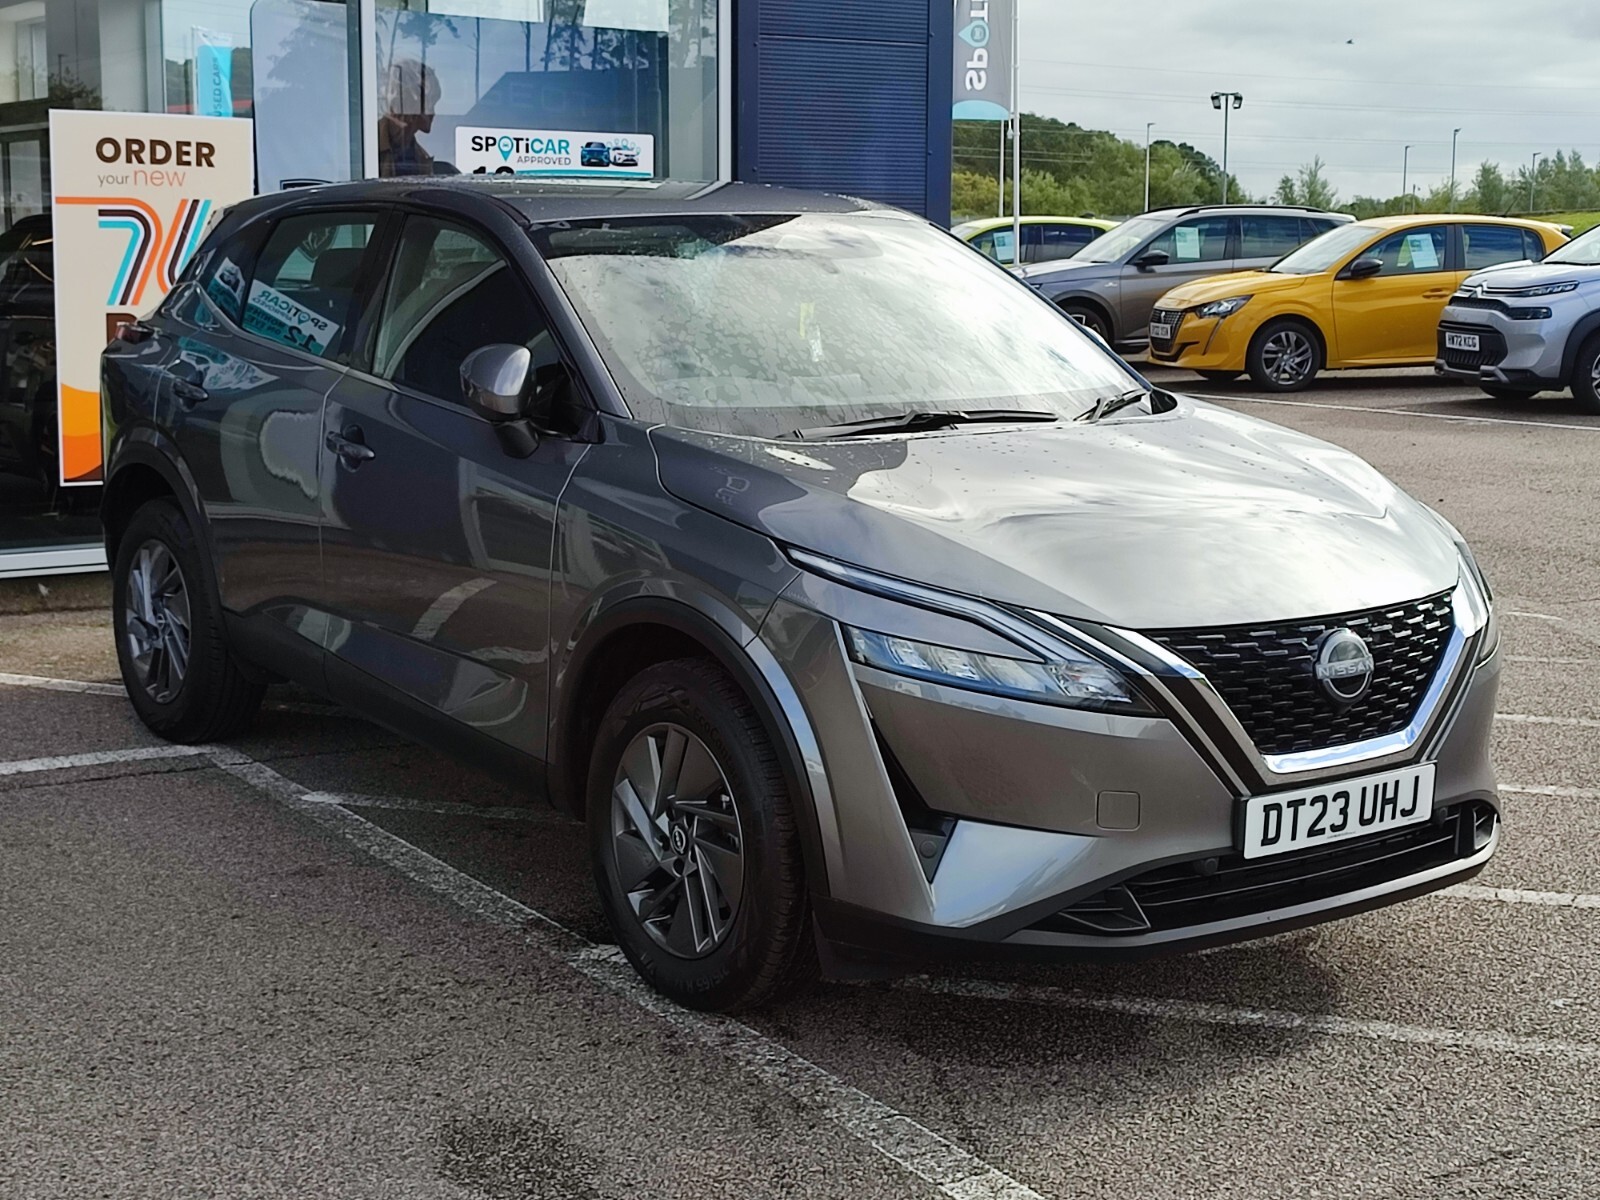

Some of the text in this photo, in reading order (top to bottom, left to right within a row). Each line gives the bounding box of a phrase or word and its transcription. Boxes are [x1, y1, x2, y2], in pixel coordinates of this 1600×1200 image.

[95, 137, 216, 168] ORDER
[516, 155, 571, 166] APPROVED
[97, 168, 186, 188] your new
[1317, 656, 1374, 680] NISSAN
[1261, 775, 1421, 848] DT23 UHJ
